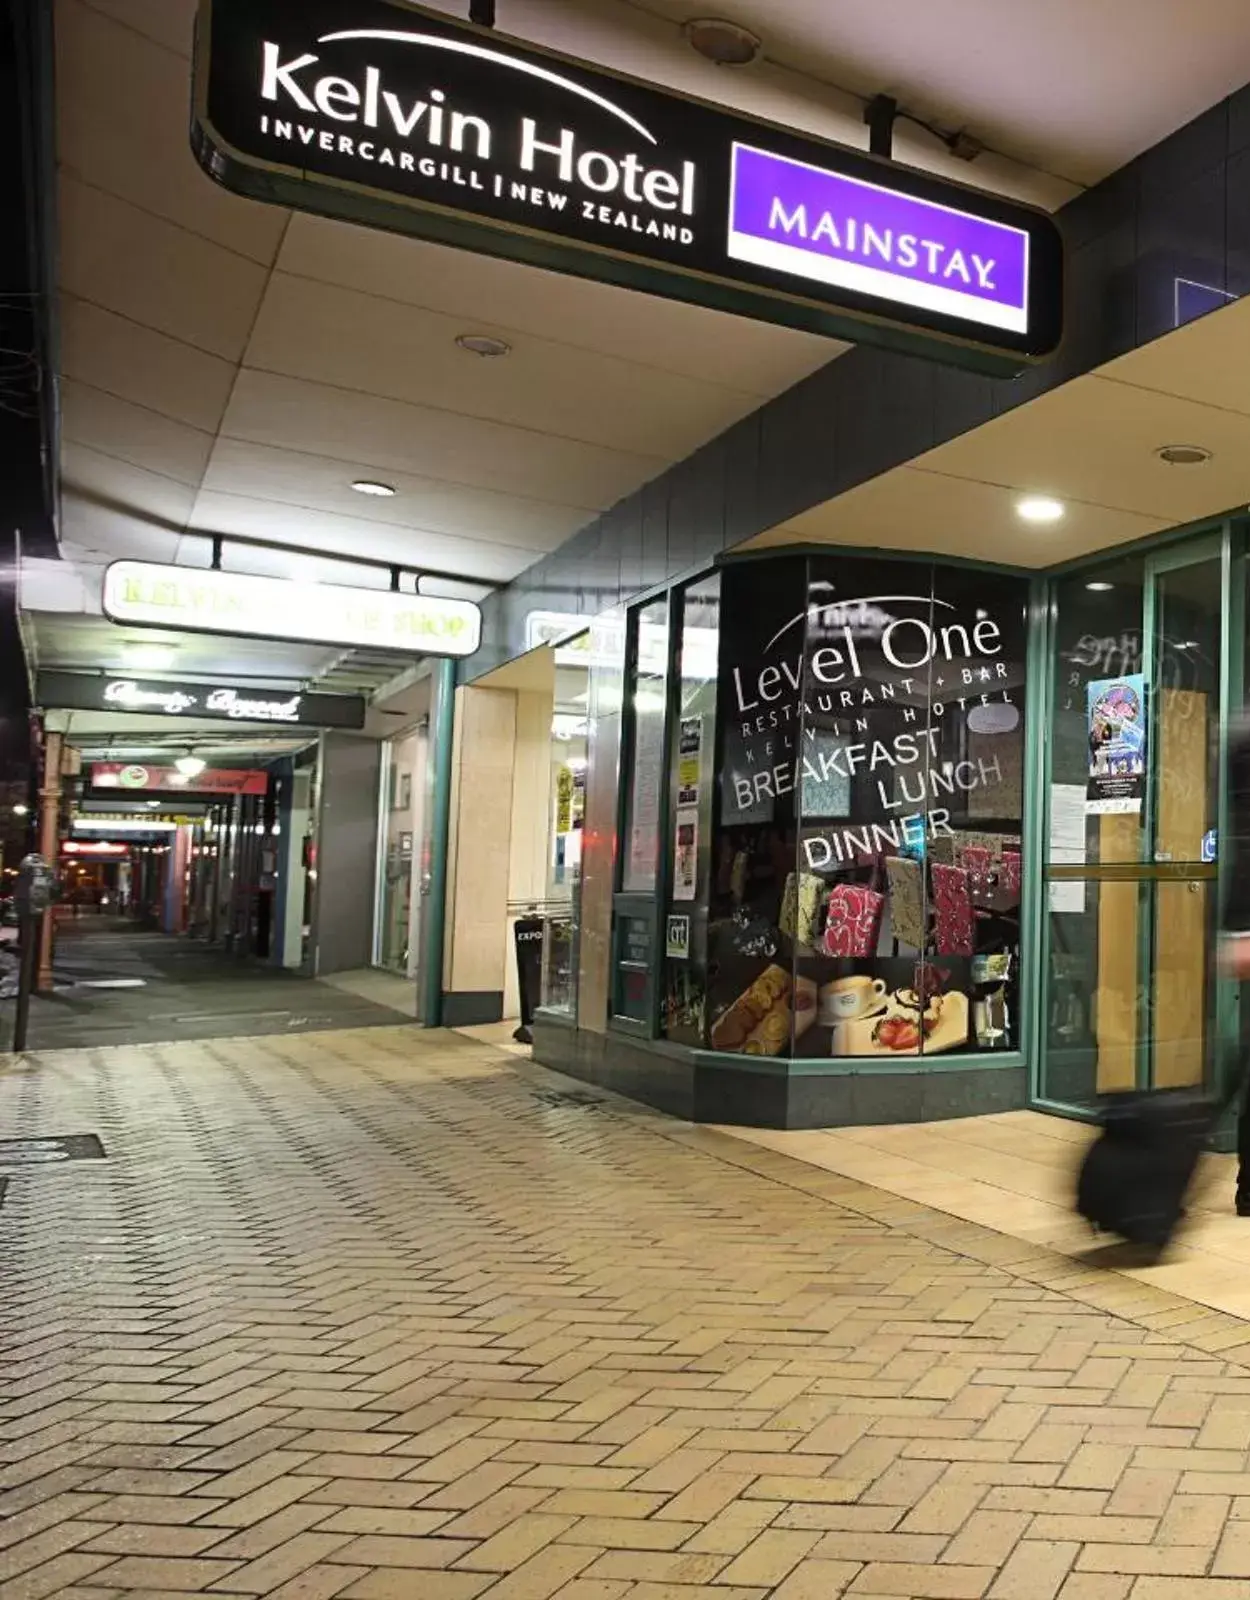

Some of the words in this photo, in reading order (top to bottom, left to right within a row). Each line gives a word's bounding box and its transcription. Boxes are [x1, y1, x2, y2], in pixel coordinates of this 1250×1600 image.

[260, 41, 491, 160] Kelvin
[520, 117, 696, 217] Hotel
[260, 115, 484, 190] INVERCARGILL
[511, 185, 568, 211] NEW
[582, 200, 695, 245] ZEALAND
[768, 197, 997, 290] MAINSTAY
[733, 626, 862, 712] Level
[881, 617, 1001, 669] One
[742, 678, 915, 738] RESTAURANT
[961, 662, 1009, 686] BAR
[746, 717, 869, 763] KELVIN
[903, 689, 1013, 723] HOTEL
[734, 727, 941, 810] BREAKFAST
[877, 753, 1002, 810] LUNCH
[802, 807, 955, 869] DINNER
